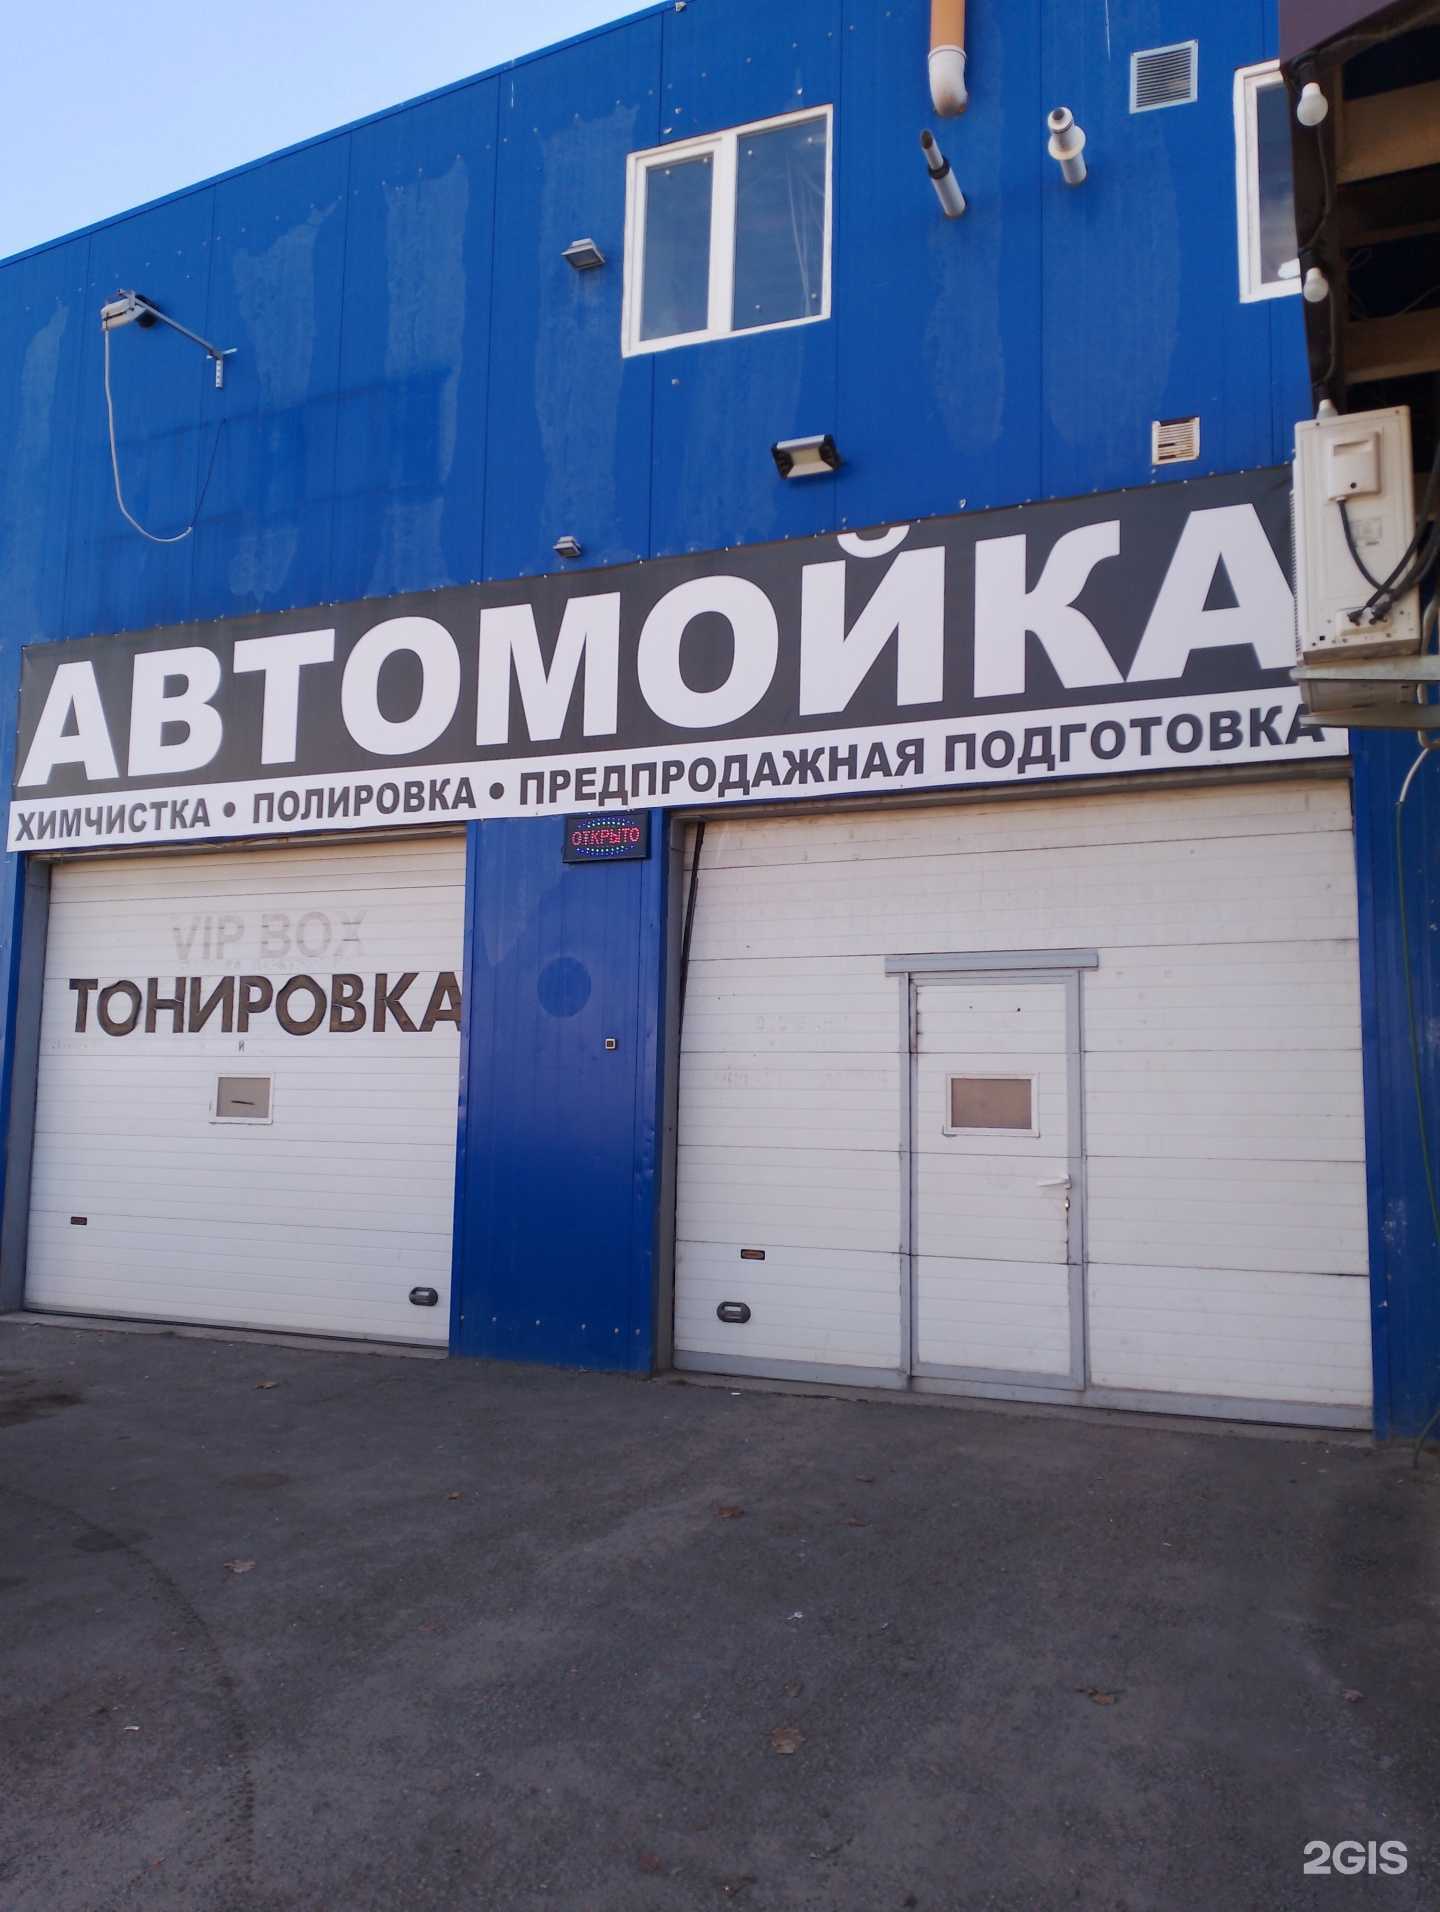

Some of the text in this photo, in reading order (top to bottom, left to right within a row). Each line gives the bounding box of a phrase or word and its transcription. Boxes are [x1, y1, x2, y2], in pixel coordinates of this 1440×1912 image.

[18, 503, 1298, 787] АВТОМОЙКА
[15, 703, 1325, 842] ХИМЧИСТКА ПОЛИРОВКА ПРЕДПРОДАЖНАЯ ПОДГОТОВКА
[571, 827, 640, 846] ОТКРЫТО
[172, 909, 370, 962] VIP BOX
[68, 971, 463, 1037] ТОНИРОВКА
